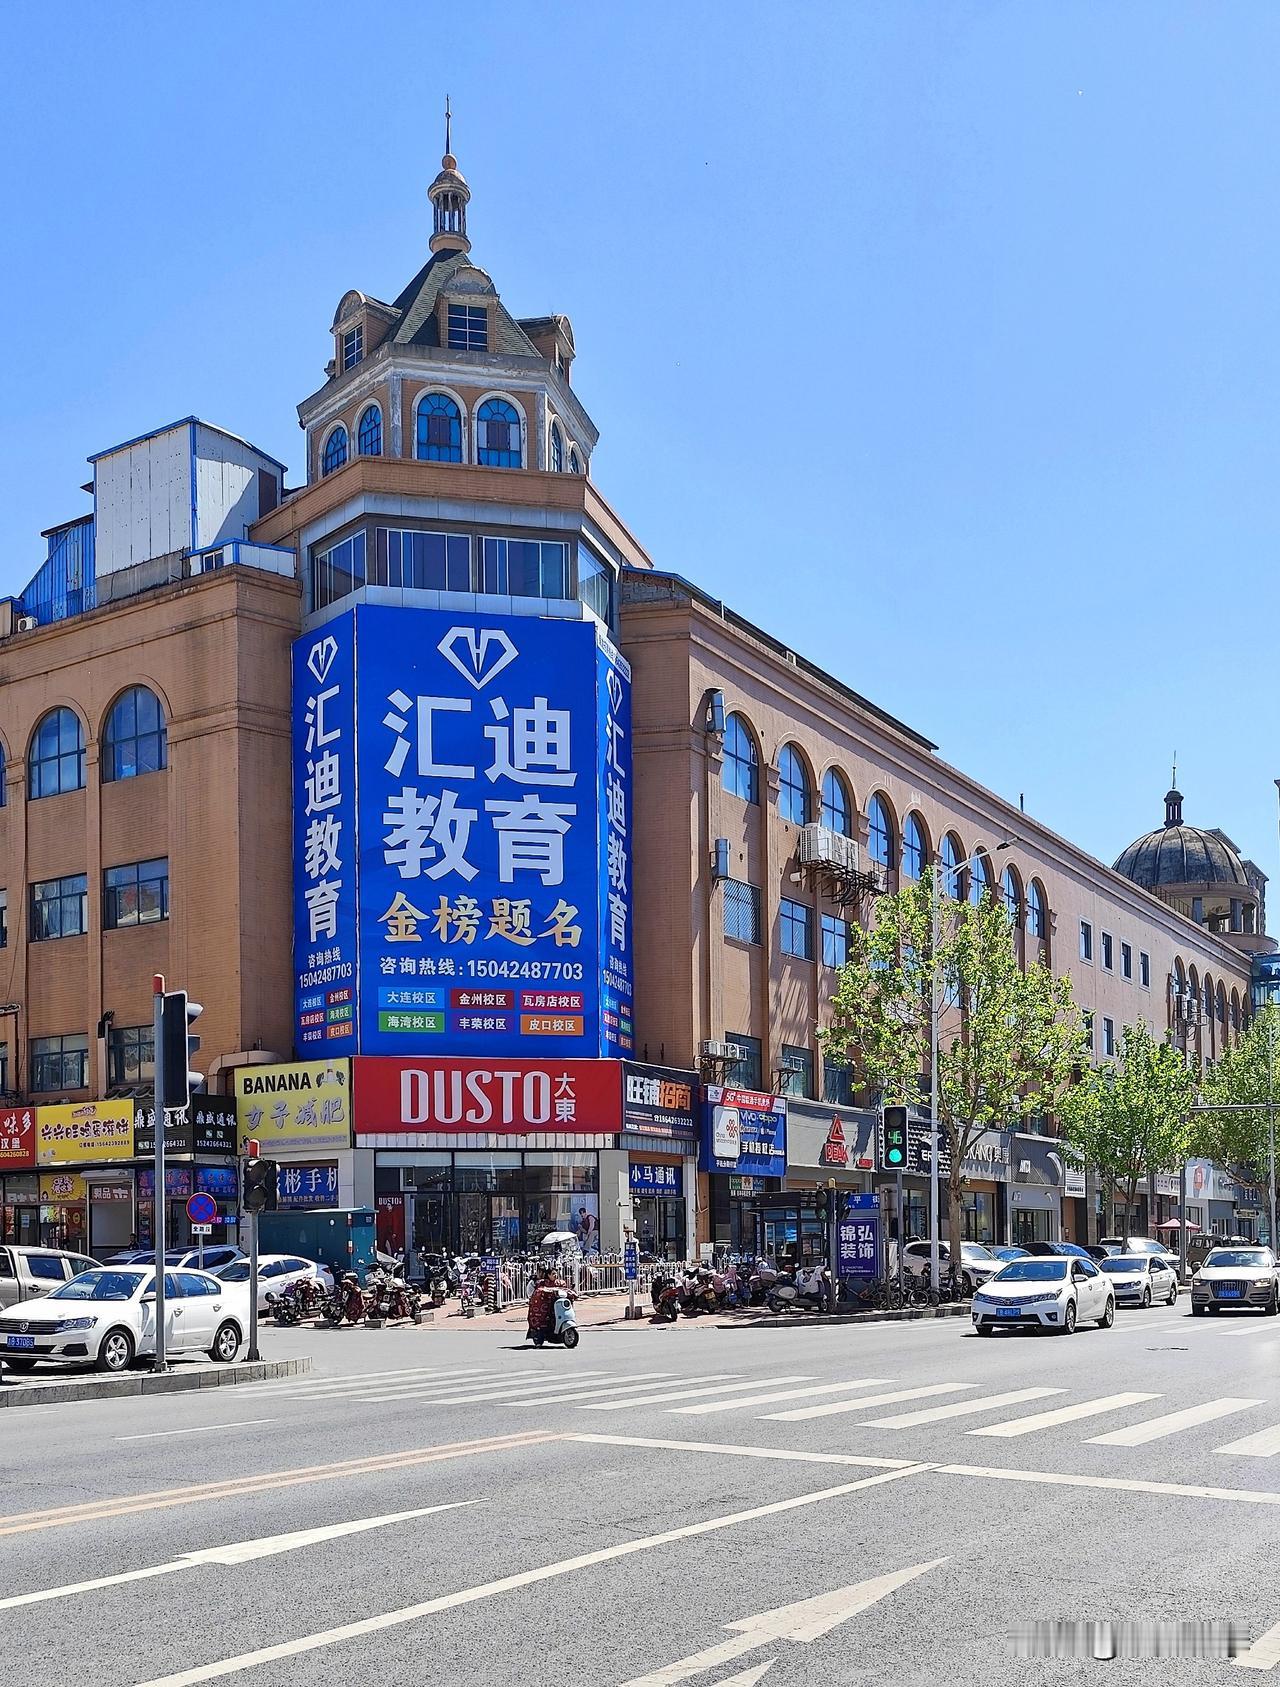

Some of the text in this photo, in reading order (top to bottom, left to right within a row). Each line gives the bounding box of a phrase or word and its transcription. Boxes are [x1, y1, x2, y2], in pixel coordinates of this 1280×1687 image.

[382, 688, 578, 788] 汇迪
[304, 684, 343, 943] 汇迪教育
[382, 786, 578, 886] 教育
[605, 712, 628, 952] 汇迪教育
[377, 891, 584, 948] 金榜题名
[307, 946, 342, 968] 咨询热线
[299, 962, 353, 989] 15042487703
[386, 991, 436, 1005] 大连校区
[458, 993, 507, 1007] 金州校区
[522, 994, 581, 1008] 瓦房店校区
[387, 1016, 436, 1029] 海湾校区
[458, 1018, 507, 1031] 丰荣校区
[528, 1019, 576, 1032] 皮口校区
[243, 1072, 312, 1095] BANANA
[626, 1075, 691, 1111] 旺铺招商
[400, 1069, 551, 1124] DUSTO
[553, 1072, 576, 1123] 大東
[0, 1111, 32, 1137] 味多
[245, 1096, 345, 1132] 女子减肥
[1, 1138, 20, 1149] 汉堡
[888, 1131, 903, 1145] 46
[825, 1144, 849, 1163] PEAK
[921, 1149, 944, 1162] ERE
[631, 1165, 676, 1185] 小马通讯
[840, 1225, 874, 1242] 锦弘
[840, 1242, 874, 1259] 装饰
